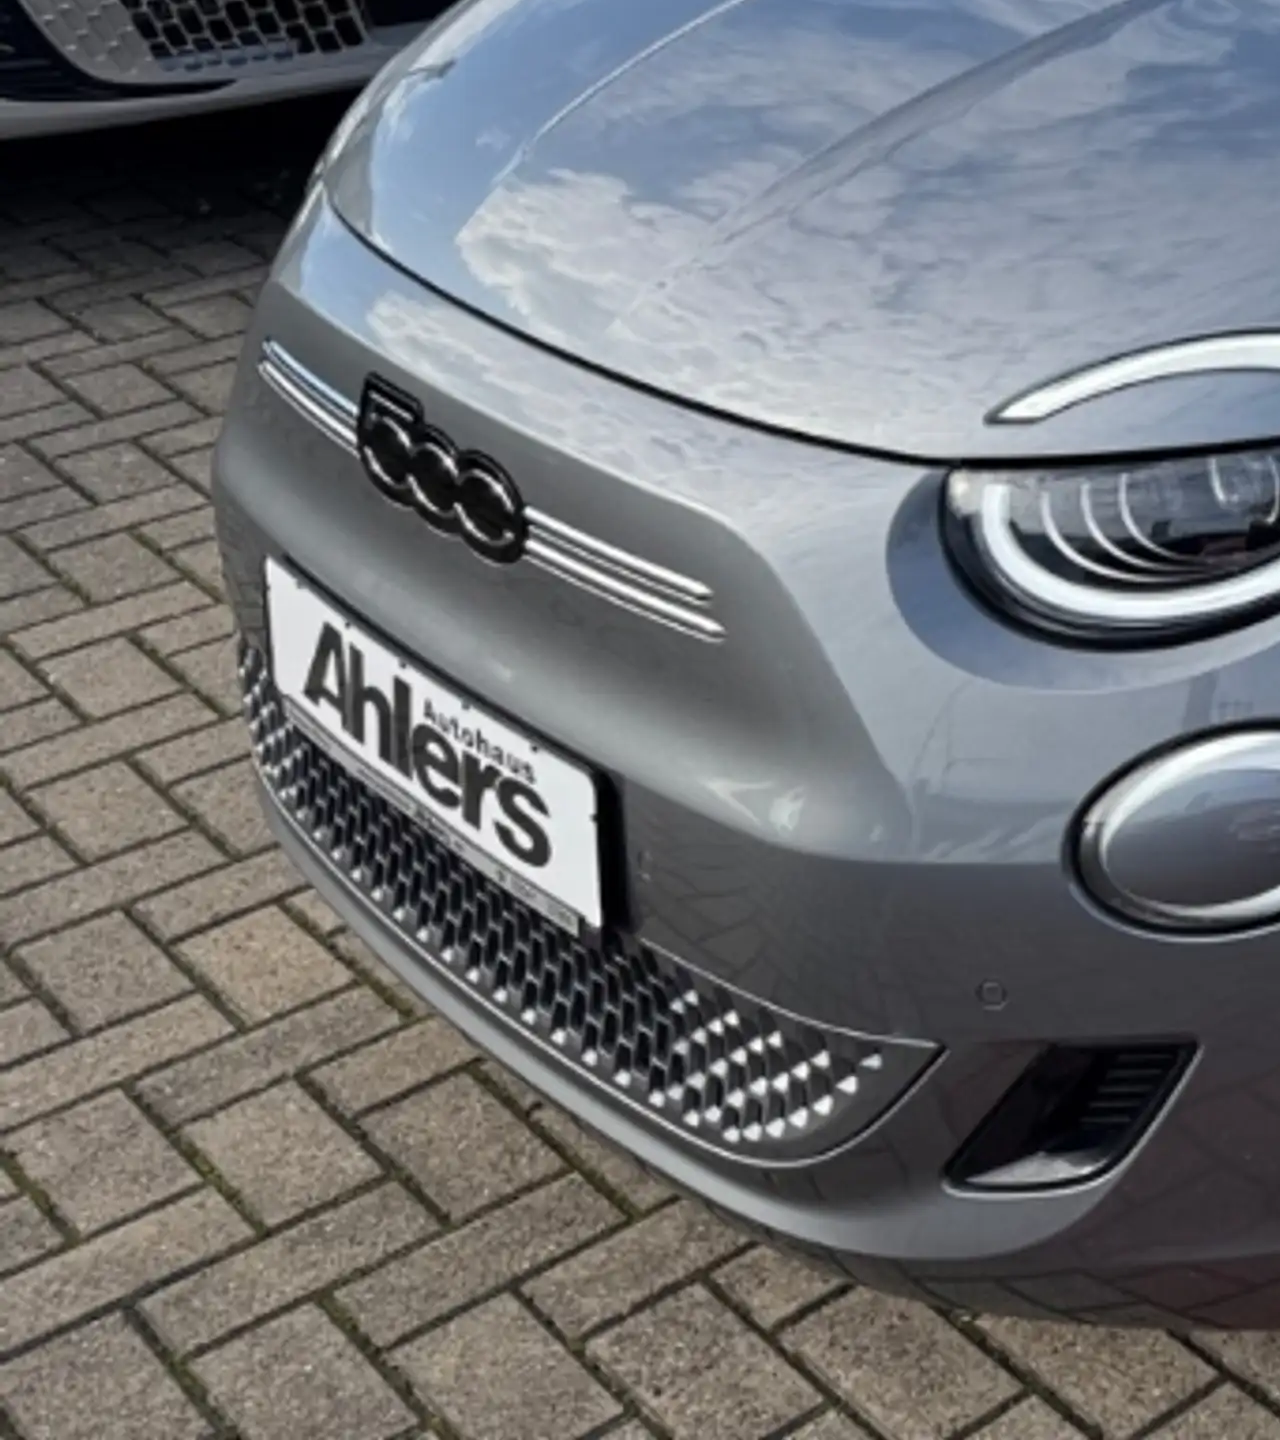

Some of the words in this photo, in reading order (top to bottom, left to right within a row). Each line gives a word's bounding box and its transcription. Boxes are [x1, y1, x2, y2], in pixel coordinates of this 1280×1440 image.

[357, 371, 528, 564] 500
[302, 620, 552, 869] Ahlers
[423, 699, 538, 786] Autohaus
